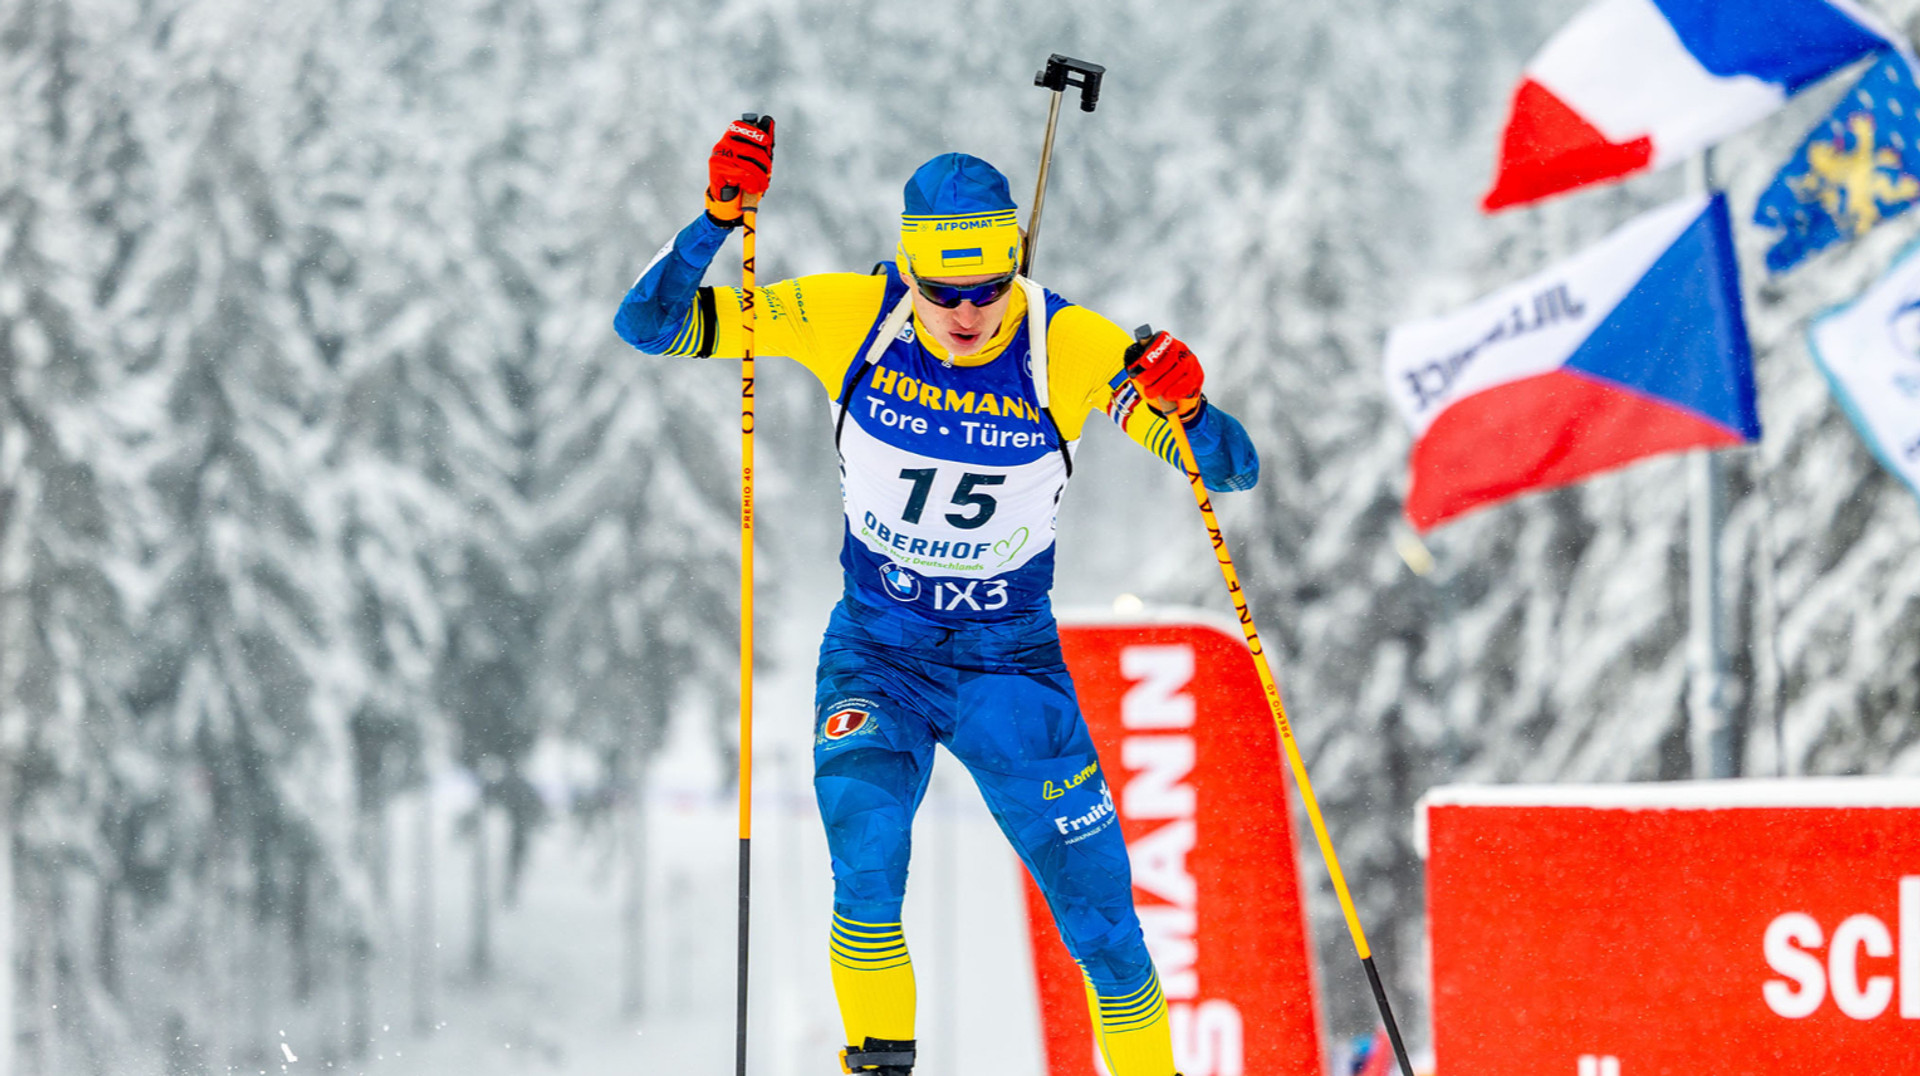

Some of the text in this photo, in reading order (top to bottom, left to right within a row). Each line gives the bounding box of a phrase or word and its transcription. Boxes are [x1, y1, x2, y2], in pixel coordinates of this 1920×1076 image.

[935, 219, 993, 231] АГРОМАТ
[870, 365, 1040, 424] HÖRMANN
[865, 395, 928, 435] Tore
[960, 421, 1046, 448] Türen
[743, 467, 752, 529] PREMIO 40
[898, 468, 1007, 530] 15
[864, 510, 991, 560] OBERHOF
[912, 556, 985, 572] Deutschlands
[1272, 698, 1291, 739] PREMIO
